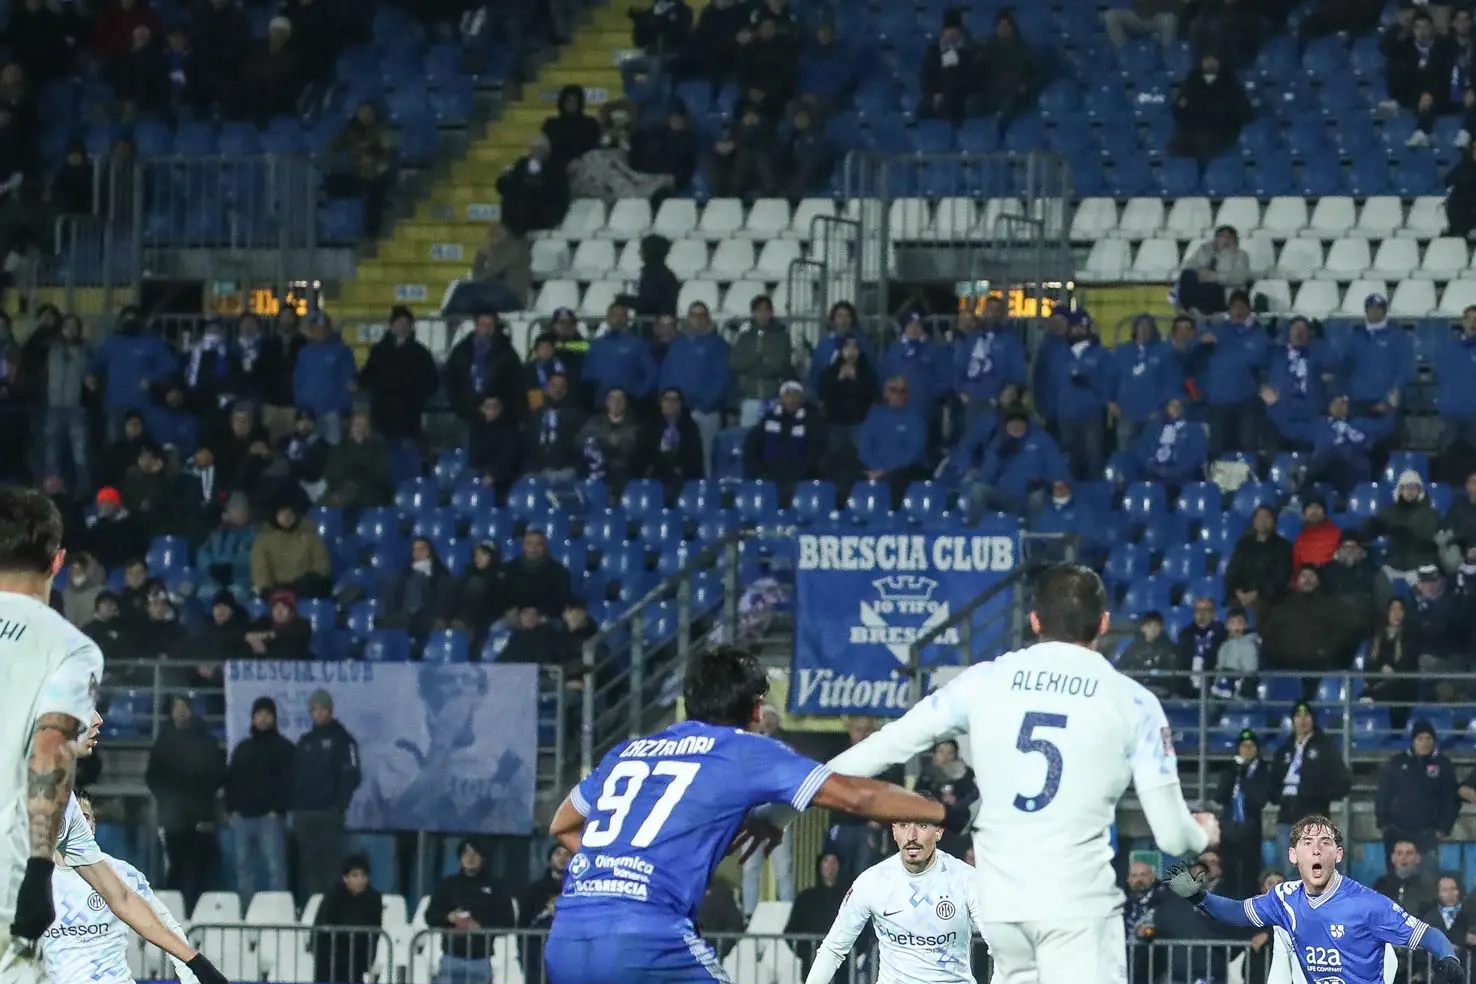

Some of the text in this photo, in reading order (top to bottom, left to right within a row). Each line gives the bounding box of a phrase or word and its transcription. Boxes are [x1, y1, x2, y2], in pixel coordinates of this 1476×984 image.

[799, 534, 1013, 571] BRESCIA CLUB
[1011, 669, 1099, 698] ALEXIOU
[1012, 711, 1069, 813] 5
[581, 760, 702, 848] 97
[886, 928, 957, 946] betsson
[1305, 946, 1342, 966] a2a
